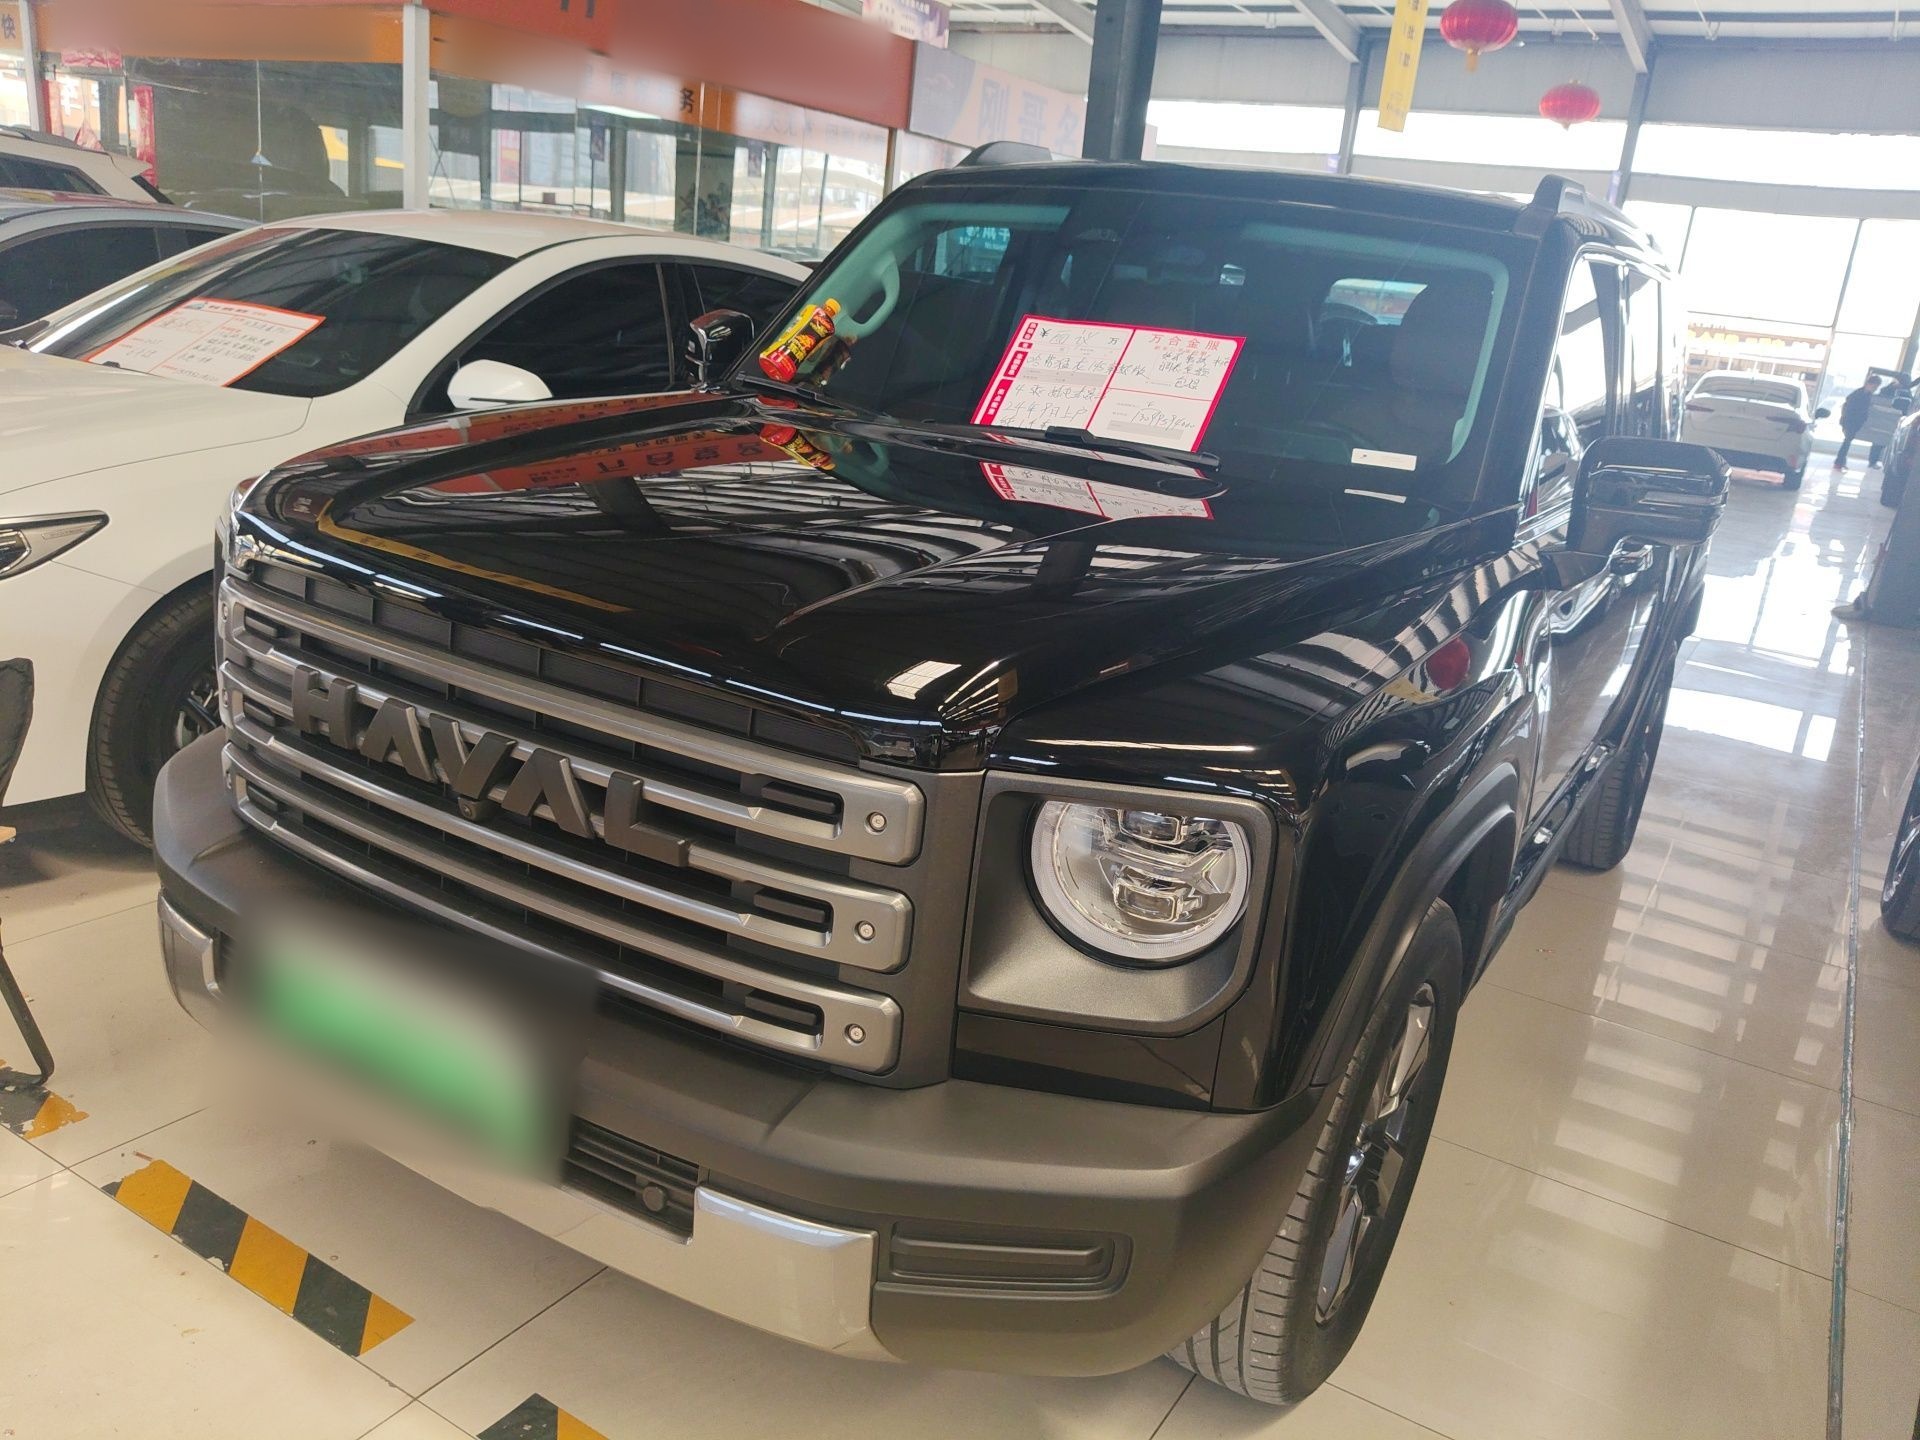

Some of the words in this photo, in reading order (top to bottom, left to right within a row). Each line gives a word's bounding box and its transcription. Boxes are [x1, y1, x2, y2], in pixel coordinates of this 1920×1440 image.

[680, 87, 694, 113] 务
[1148, 333, 1222, 352] 万合金服
[292, 664, 690, 867] HAVAL
